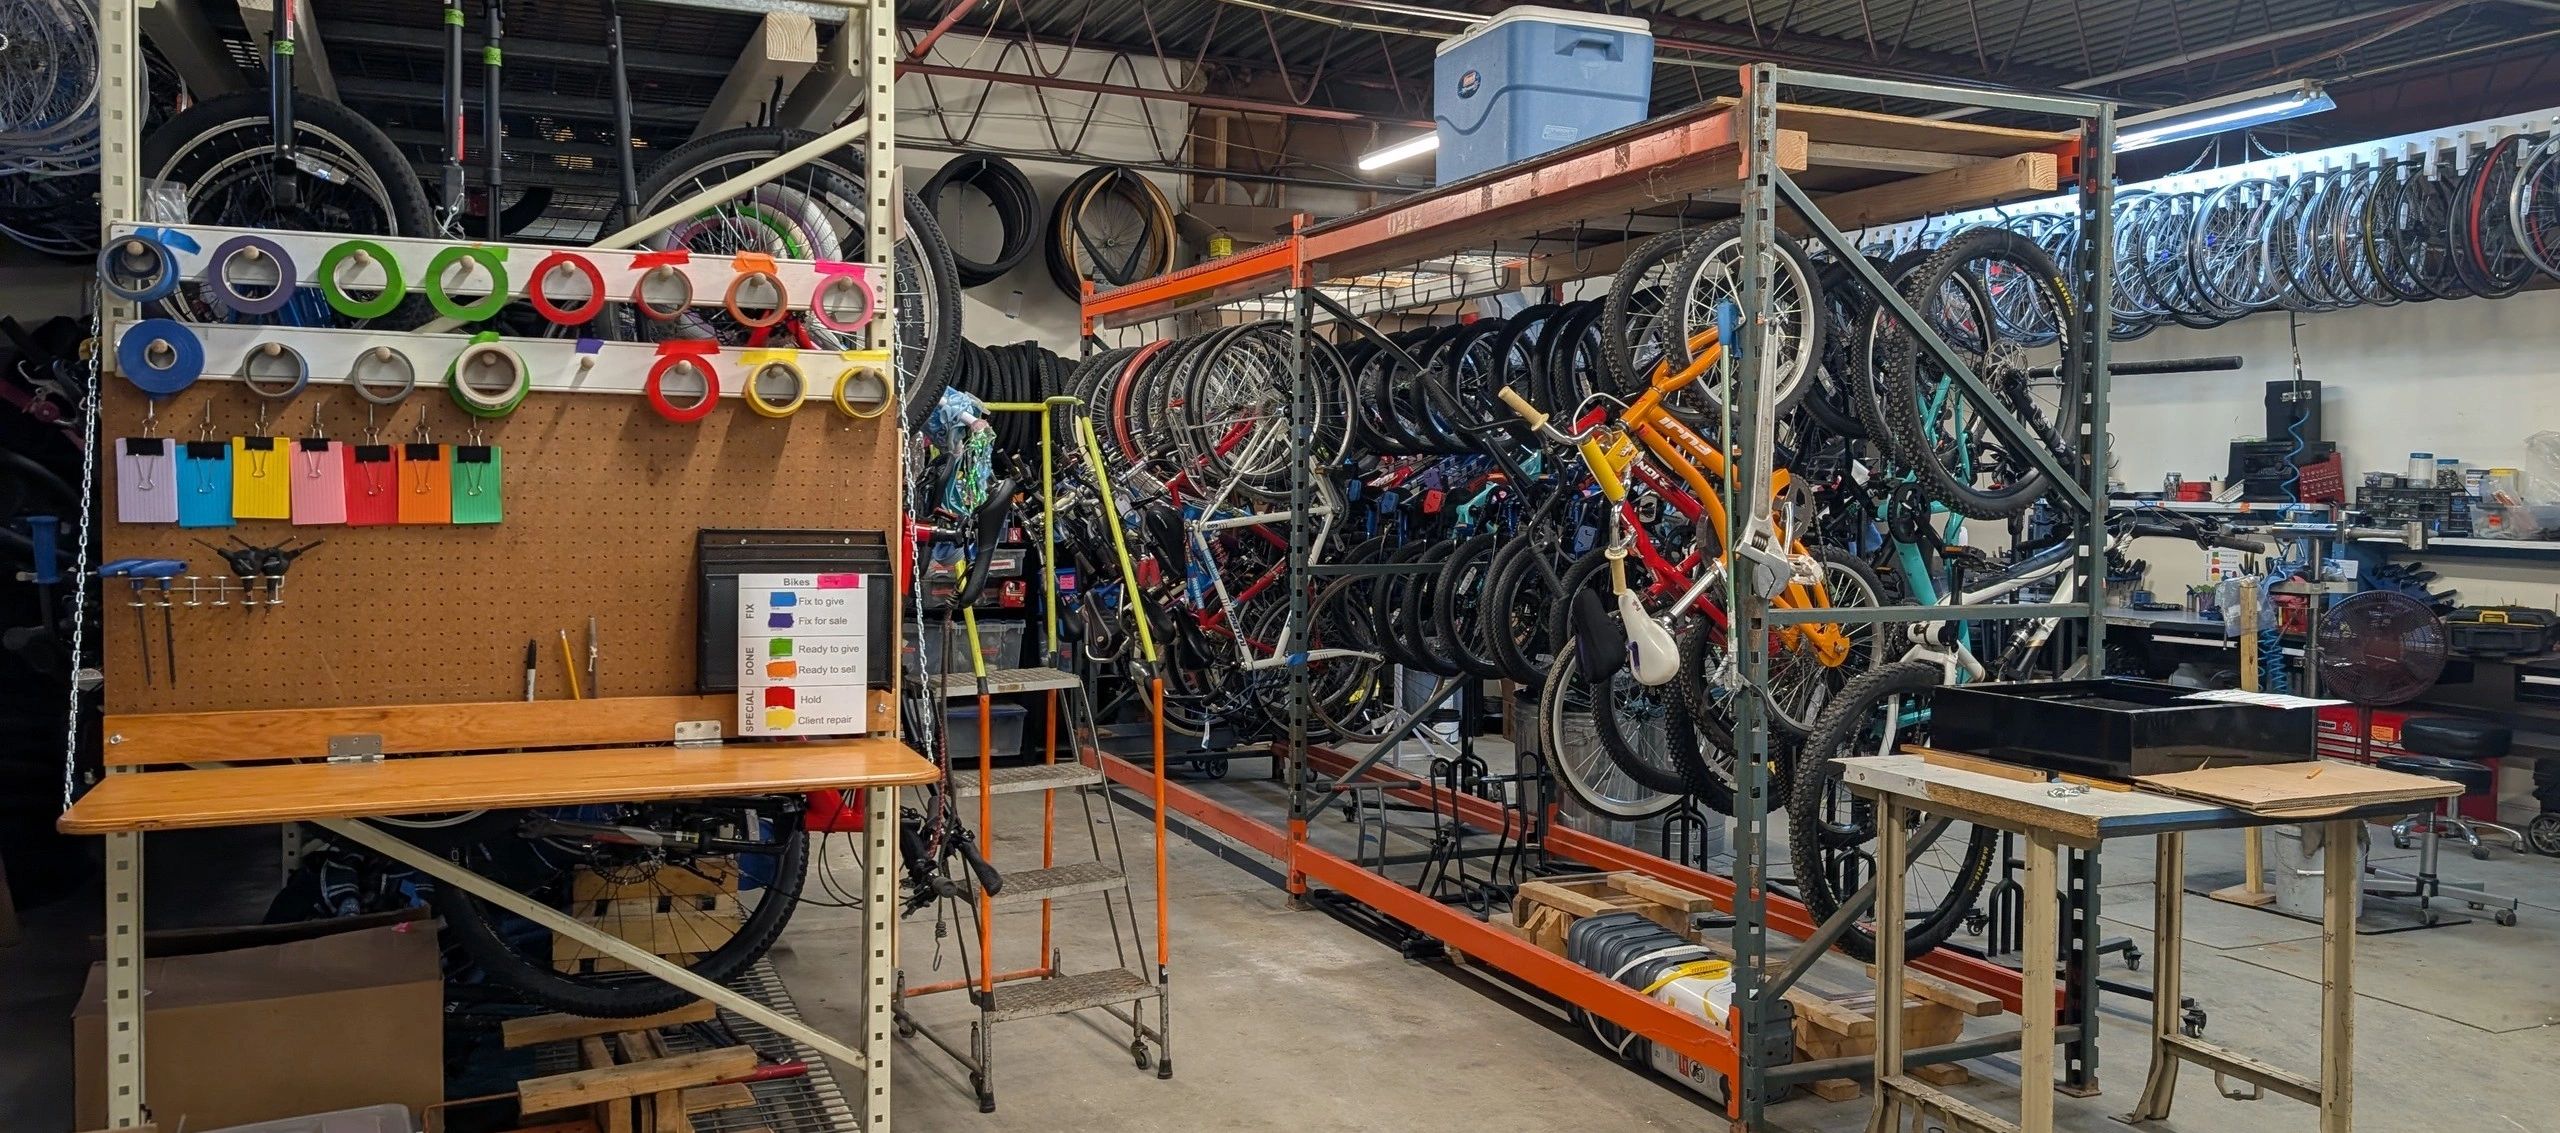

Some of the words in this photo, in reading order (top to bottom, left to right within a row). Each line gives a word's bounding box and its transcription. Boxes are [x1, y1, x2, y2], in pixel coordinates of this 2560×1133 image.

[903, 298, 913, 328] XR2
[783, 577, 810, 587] Bikes
[798, 596, 812, 606] Fix
[813, 597, 823, 606] to
[825, 597, 845, 608] give
[745, 603, 755, 619] FIX
[798, 616, 812, 625] Fix
[813, 616, 827, 625] for
[829, 616, 848, 625] sale
[798, 645, 828, 655] Ready
[830, 645, 840, 653] to
[840, 645, 860, 656] give
[745, 647, 755, 676] DONE
[798, 665, 829, 676] Ready
[830, 666, 840, 674] to
[841, 665, 856, 674] sell
[800, 695, 822, 704] Hold
[745, 690, 755, 732] SPECIAL
[798, 716, 826, 725] Client
[827, 715, 853, 727] repair
